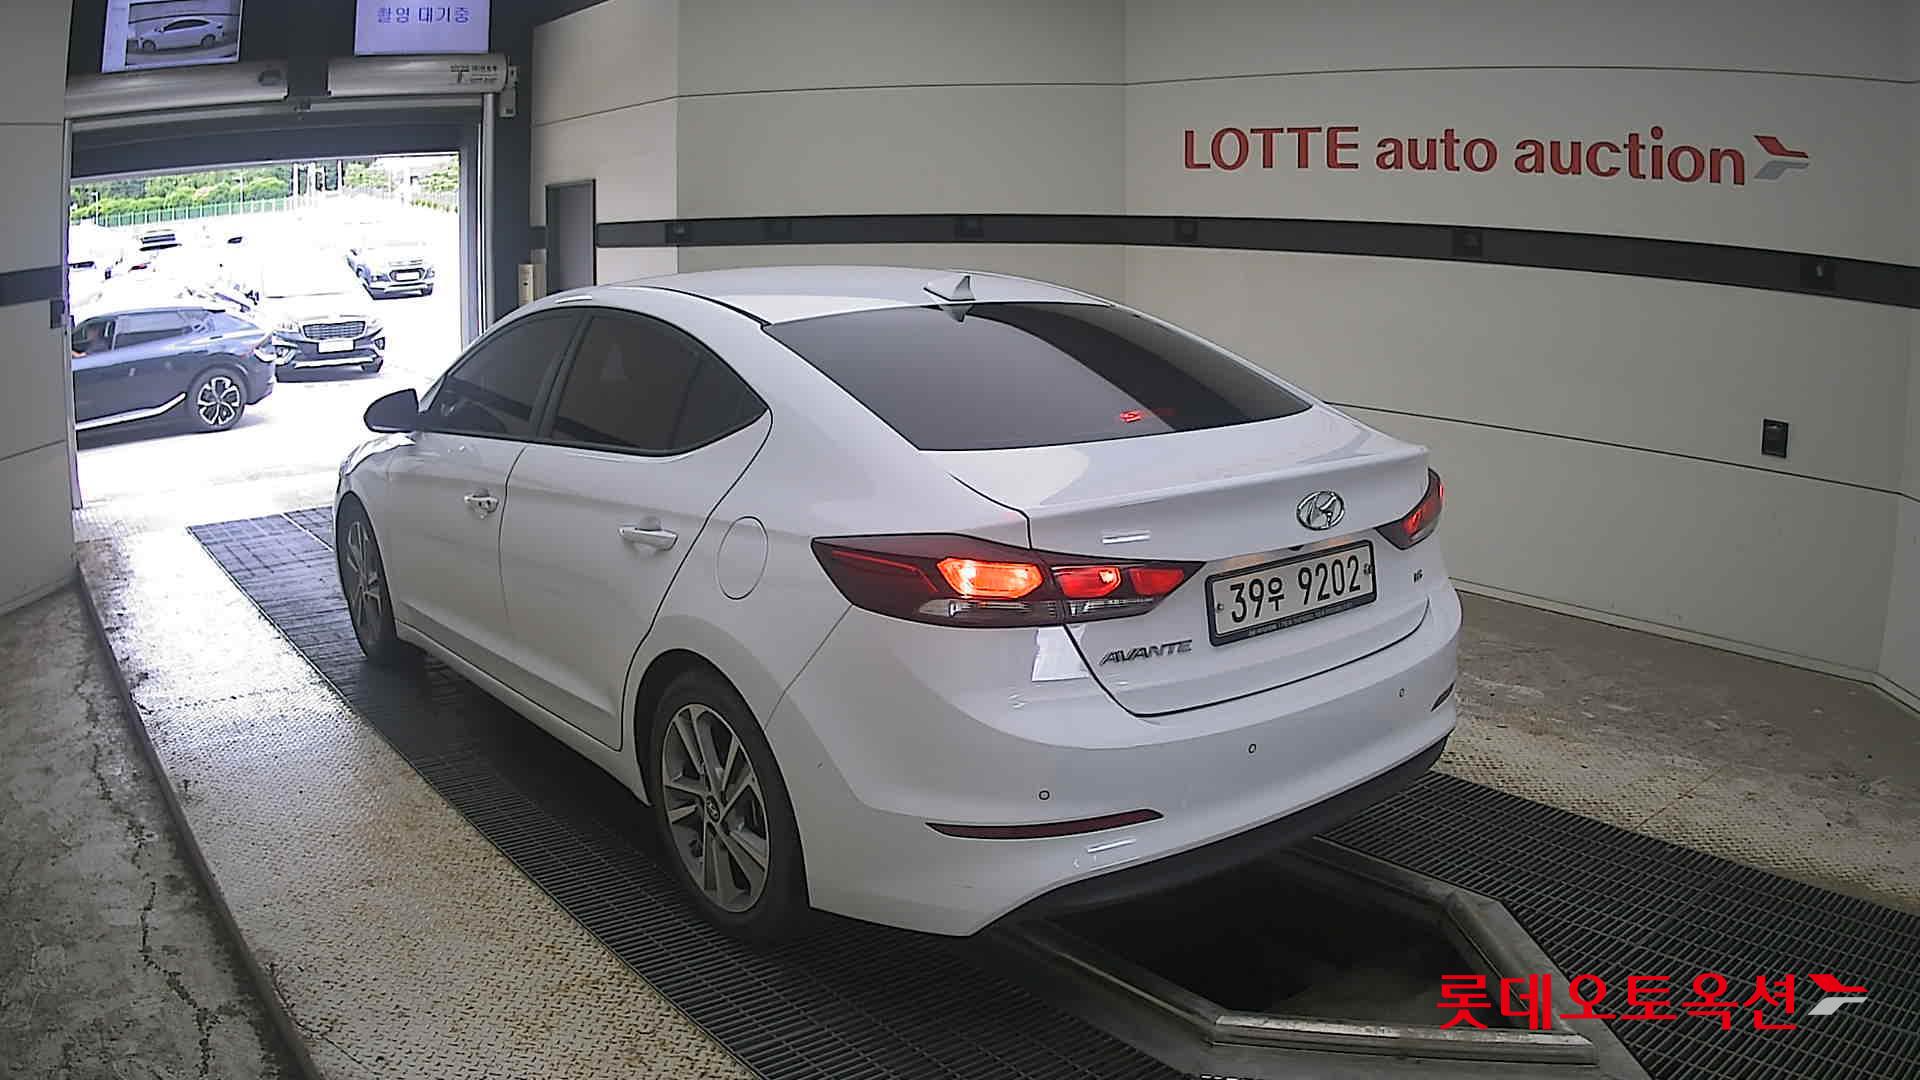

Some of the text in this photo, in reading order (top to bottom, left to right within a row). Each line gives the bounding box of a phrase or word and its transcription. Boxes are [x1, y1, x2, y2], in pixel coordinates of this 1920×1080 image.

[418, 7, 469, 24] 대기중
[1184, 126, 1745, 186] LOTTE auto auction
[1229, 577, 1285, 623] 39우
[1297, 555, 1361, 605] 9202
[1099, 639, 1193, 666] AVANTE
